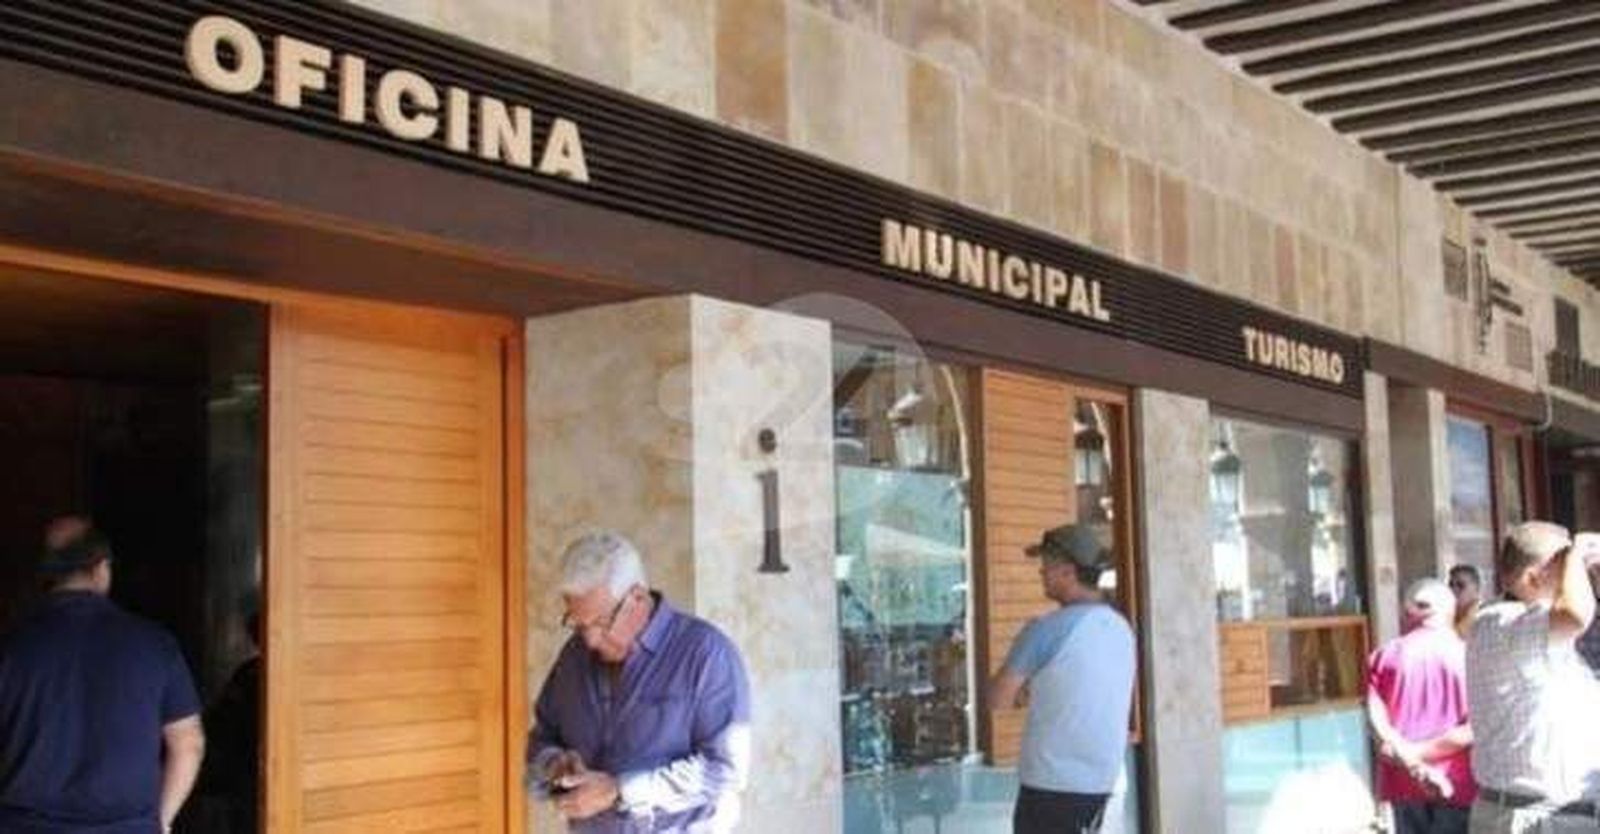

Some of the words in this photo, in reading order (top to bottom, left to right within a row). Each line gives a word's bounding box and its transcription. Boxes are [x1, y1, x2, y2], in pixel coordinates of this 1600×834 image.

[184, 15, 591, 184] OFICINA
[880, 218, 1111, 321] MUNICIPAL
[1242, 326, 1345, 384] TURISMO
[754, 427, 790, 574] i
